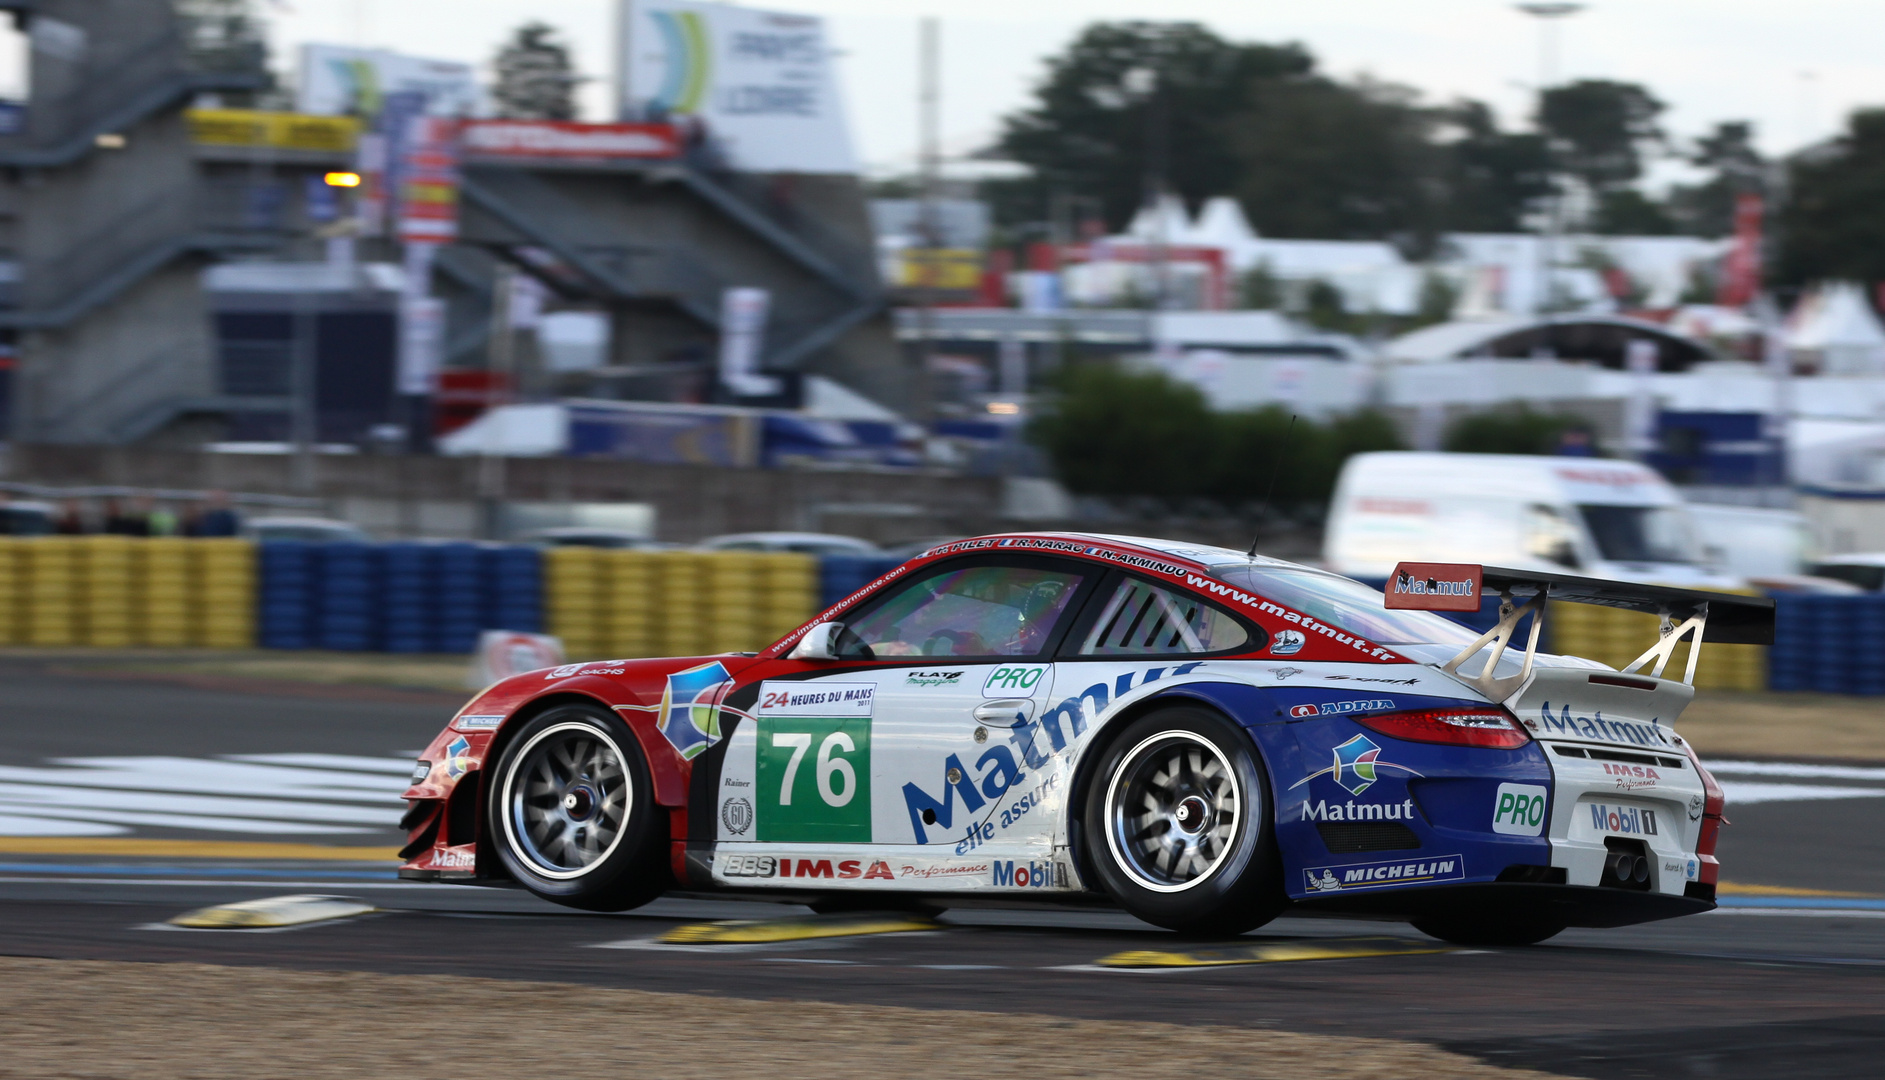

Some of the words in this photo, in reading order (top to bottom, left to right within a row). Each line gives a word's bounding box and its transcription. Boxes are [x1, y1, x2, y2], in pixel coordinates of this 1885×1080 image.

[951, 539, 997, 551] PILET
[1394, 576, 1474, 598] Matmut
[771, 565, 907, 653] www.imsa-performance.com
[1186, 573, 1396, 661] www.matmut.fr
[985, 667, 1043, 689] PRO
[761, 692, 790, 709] 24
[791, 692, 826, 706] HEURES
[828, 691, 842, 702] DU
[844, 688, 873, 701] MANS
[1321, 700, 1396, 716] ADRIA
[1541, 700, 1674, 750] Matmut
[902, 661, 1208, 846] Matmut
[772, 732, 856, 808] 76
[1603, 763, 1661, 780] IMSA
[724, 778, 751, 788] Rainer
[731, 805, 745, 826] 60
[955, 820, 995, 857] elle
[1000, 772, 1060, 829] assure
[1301, 799, 1414, 822] Matmut
[1494, 793, 1545, 827] PRO
[1591, 804, 1640, 834] Mobil
[723, 855, 777, 877] BBS
[779, 858, 896, 880] IMSA
[900, 863, 990, 879] Performance
[993, 860, 1054, 887] Mobil
[1344, 861, 1455, 882] MICHELIN
